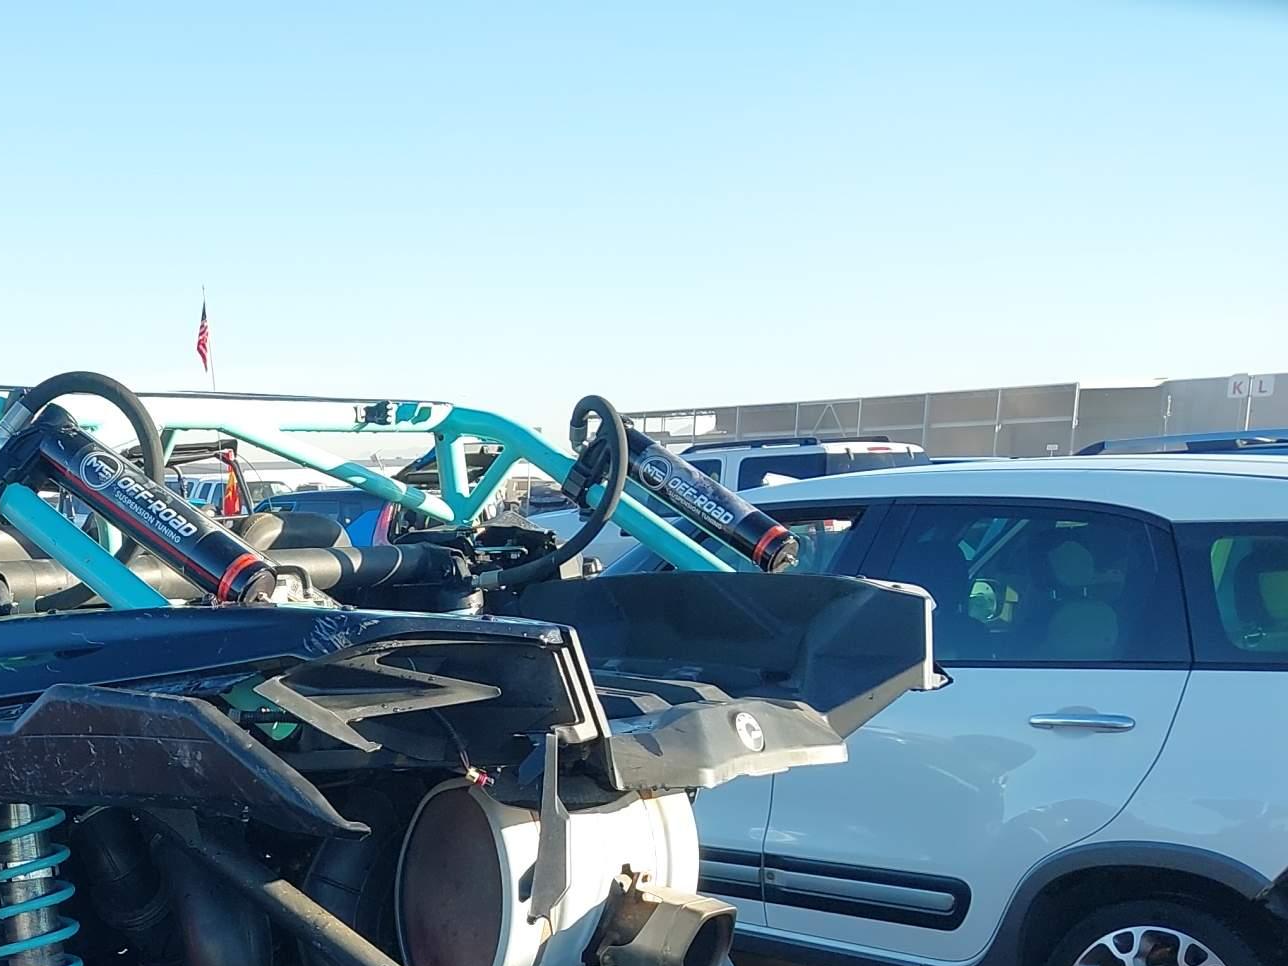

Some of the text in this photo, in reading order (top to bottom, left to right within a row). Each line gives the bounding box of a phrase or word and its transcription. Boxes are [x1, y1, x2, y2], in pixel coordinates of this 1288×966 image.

[1232, 381, 1244, 395] K
[1258, 380, 1268, 393] L
[86, 456, 116, 481] MTS
[643, 463, 666, 482] MTS
[114, 490, 181, 544] SUSPENSION TUNING
